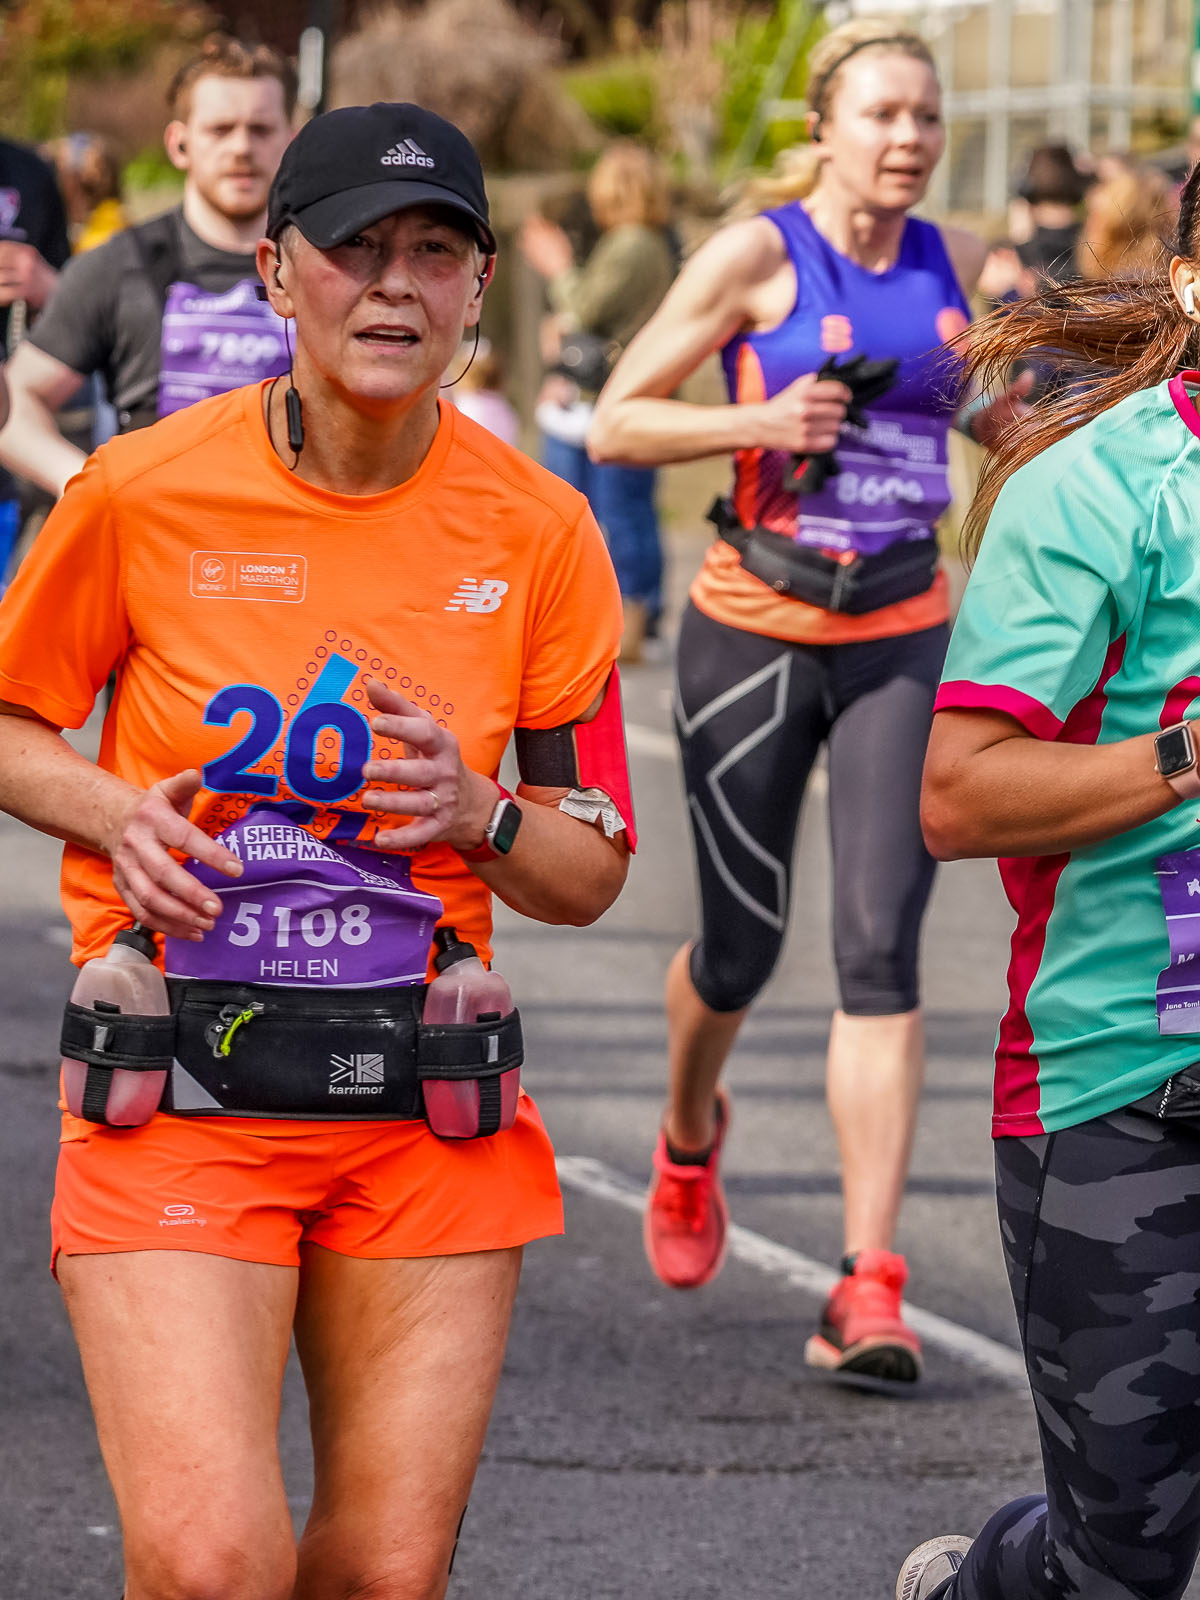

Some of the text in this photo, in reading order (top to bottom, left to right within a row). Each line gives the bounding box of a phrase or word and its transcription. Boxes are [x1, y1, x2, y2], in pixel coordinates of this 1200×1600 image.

[380, 152, 435, 168] adidas
[240, 564, 285, 574] LONDON
[240, 574, 299, 585] MARATHON
[247, 842, 296, 861] HALF
[228, 901, 372, 948] 5108
[260, 958, 339, 978] HELEN
[1165, 1003, 1183, 1011] Jane
[328, 1084, 385, 1095] karrimor
